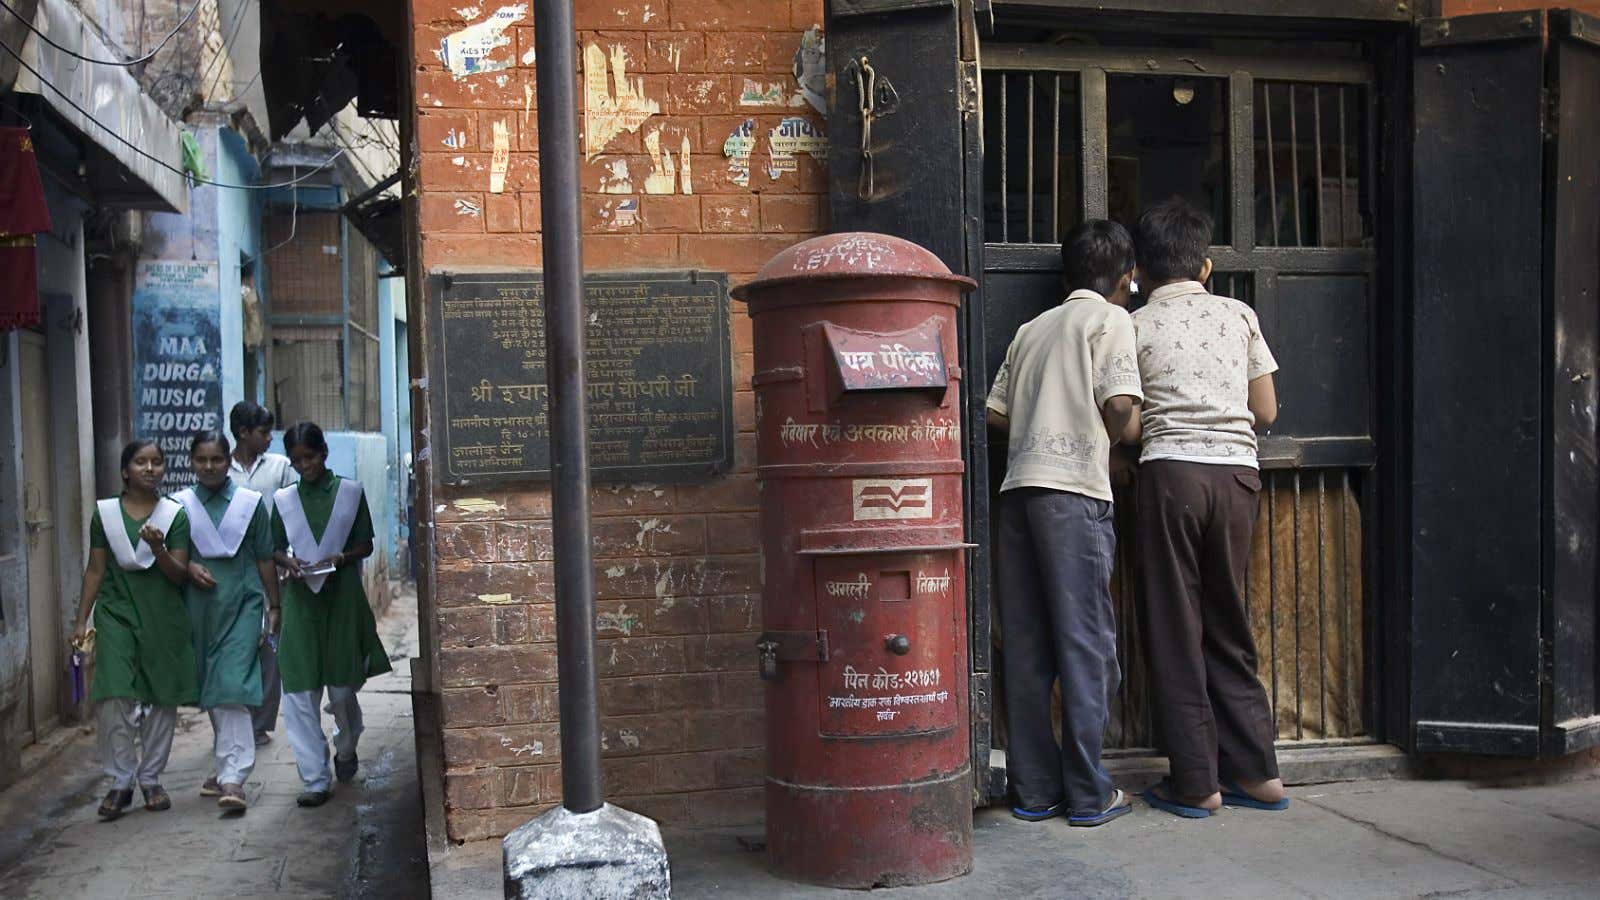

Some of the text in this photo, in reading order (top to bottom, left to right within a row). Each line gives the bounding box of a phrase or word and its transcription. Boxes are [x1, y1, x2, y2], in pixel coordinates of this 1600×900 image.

[160, 336, 207, 354] MAA
[840, 351, 877, 371] पत्र
[143, 362, 218, 382] DURGA
[142, 388, 206, 407] MUSIC
[142, 411, 218, 431] HOUSE
[844, 424, 909, 444] अवकाश
[843, 665, 869, 690] पिन
